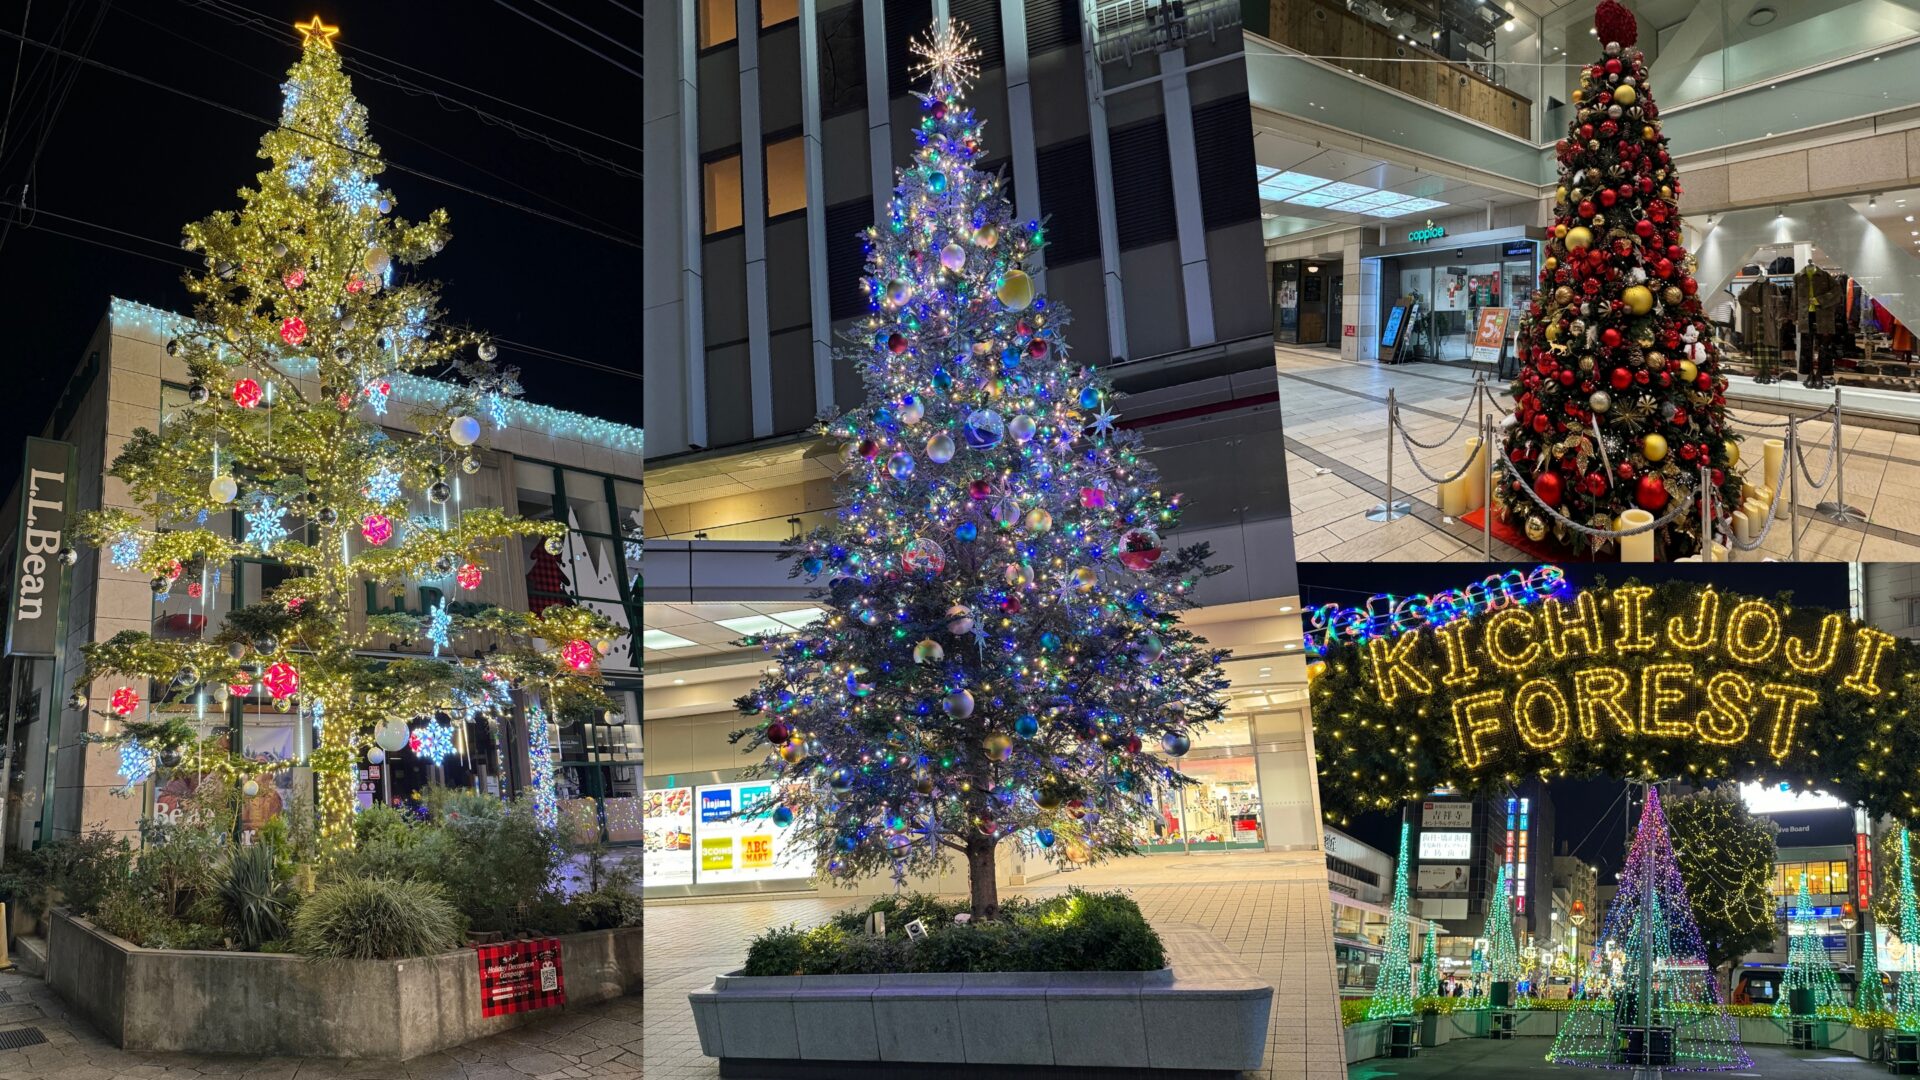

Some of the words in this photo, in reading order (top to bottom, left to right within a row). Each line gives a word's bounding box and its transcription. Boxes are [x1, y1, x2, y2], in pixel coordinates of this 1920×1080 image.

[1408, 225, 1445, 242] coppice
[18, 468, 65, 621] L.L.Bean
[1369, 585, 1895, 703] KICHIJOJI
[1451, 664, 1819, 769] FOREST
[745, 840, 768, 853] ABC
[746, 852, 768, 862] MART
